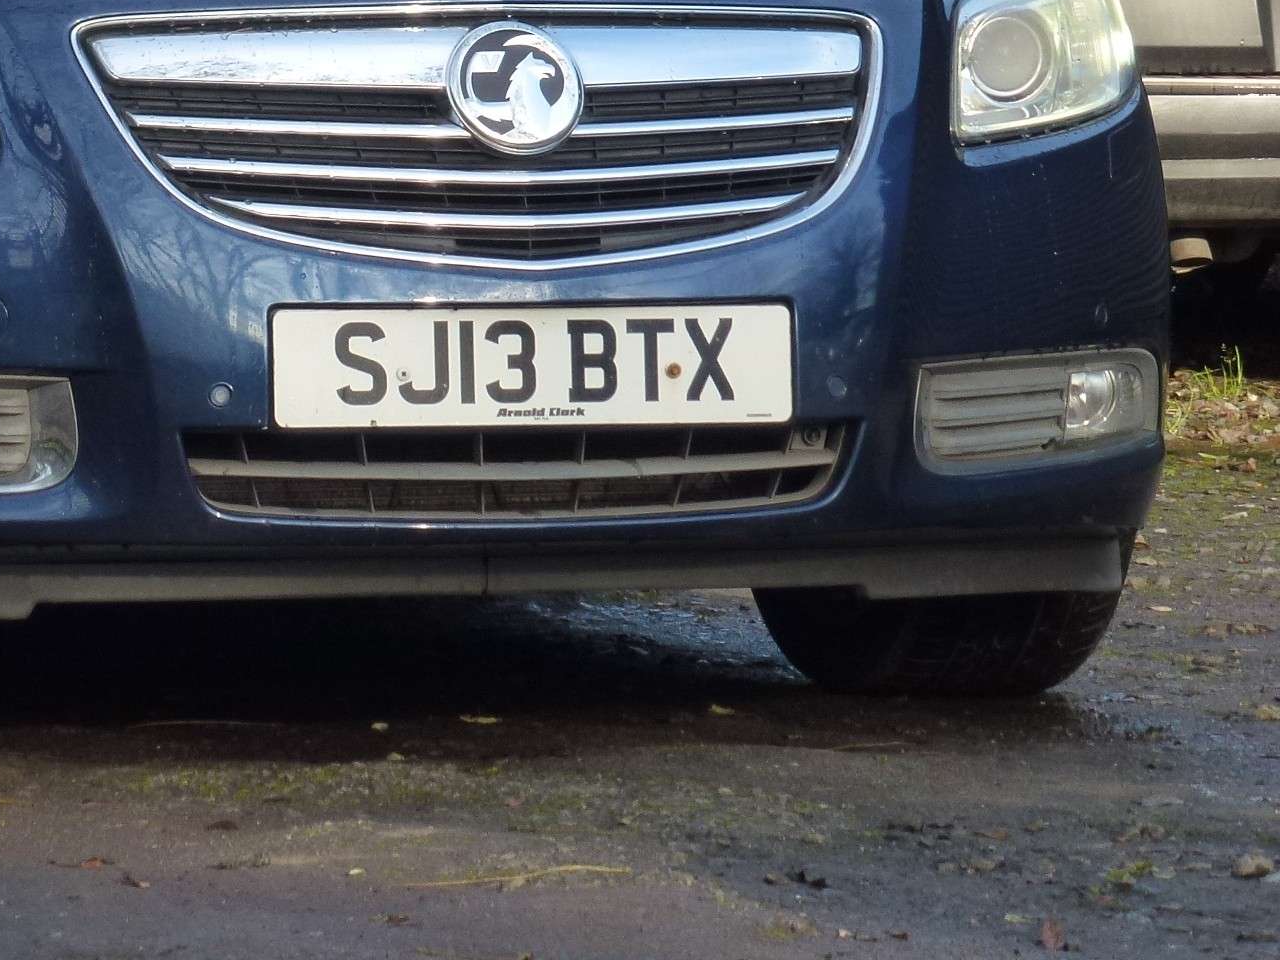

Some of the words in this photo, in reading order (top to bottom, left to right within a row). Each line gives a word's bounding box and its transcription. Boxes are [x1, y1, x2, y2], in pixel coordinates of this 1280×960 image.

[334, 320, 537, 406] SJ13
[566, 317, 735, 403] BTX
[496, 407, 546, 417] Arnold
[548, 407, 585, 417] Clark
